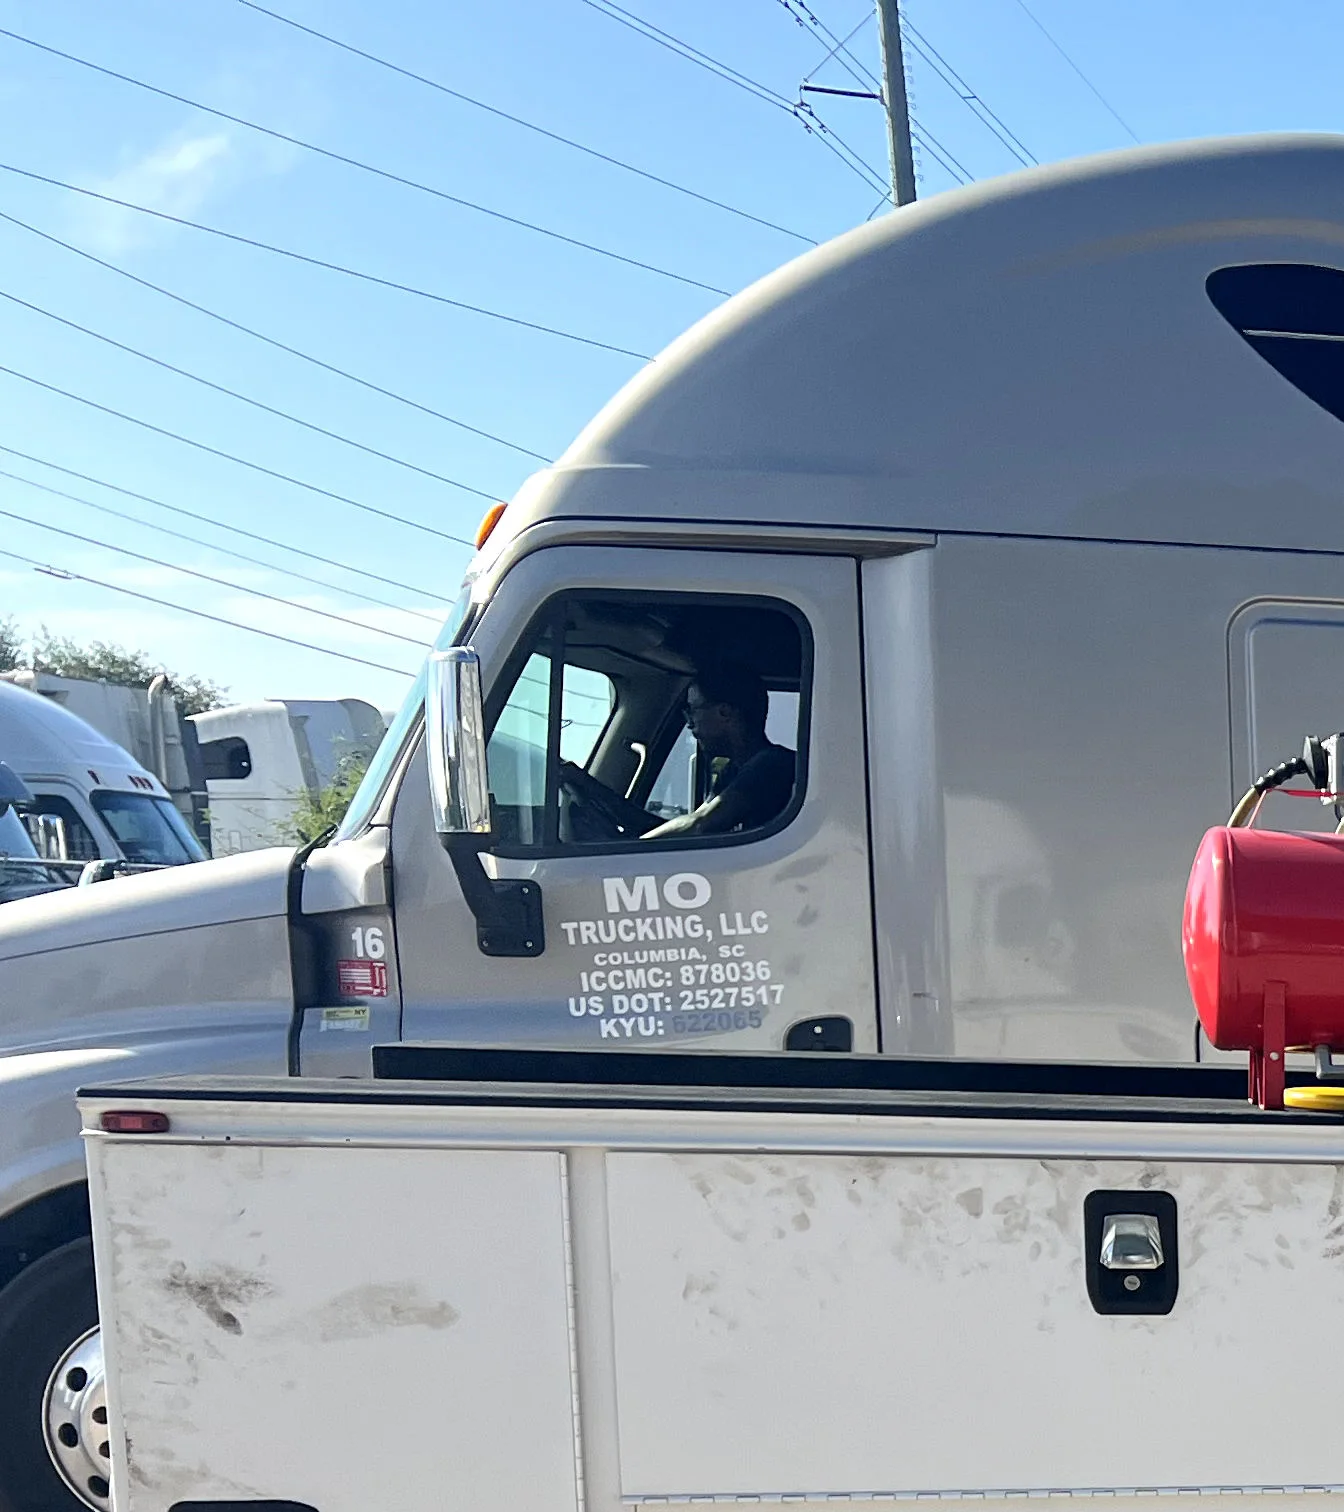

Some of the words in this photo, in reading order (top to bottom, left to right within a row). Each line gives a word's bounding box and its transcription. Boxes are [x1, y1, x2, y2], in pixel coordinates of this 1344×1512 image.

[603, 872, 712, 913] MO
[351, 926, 385, 959] 16
[561, 914, 713, 945] TRUCKING,
[719, 911, 769, 936] LLC
[593, 947, 707, 966] COLUMBIA,
[718, 944, 746, 959] SC
[580, 967, 673, 993] ICCMC:
[679, 960, 771, 986] 878036
[568, 996, 604, 1017] US
[612, 992, 673, 1014] DOT:
[678, 984, 785, 1011] 2527517
[600, 1016, 665, 1039] KYU:
